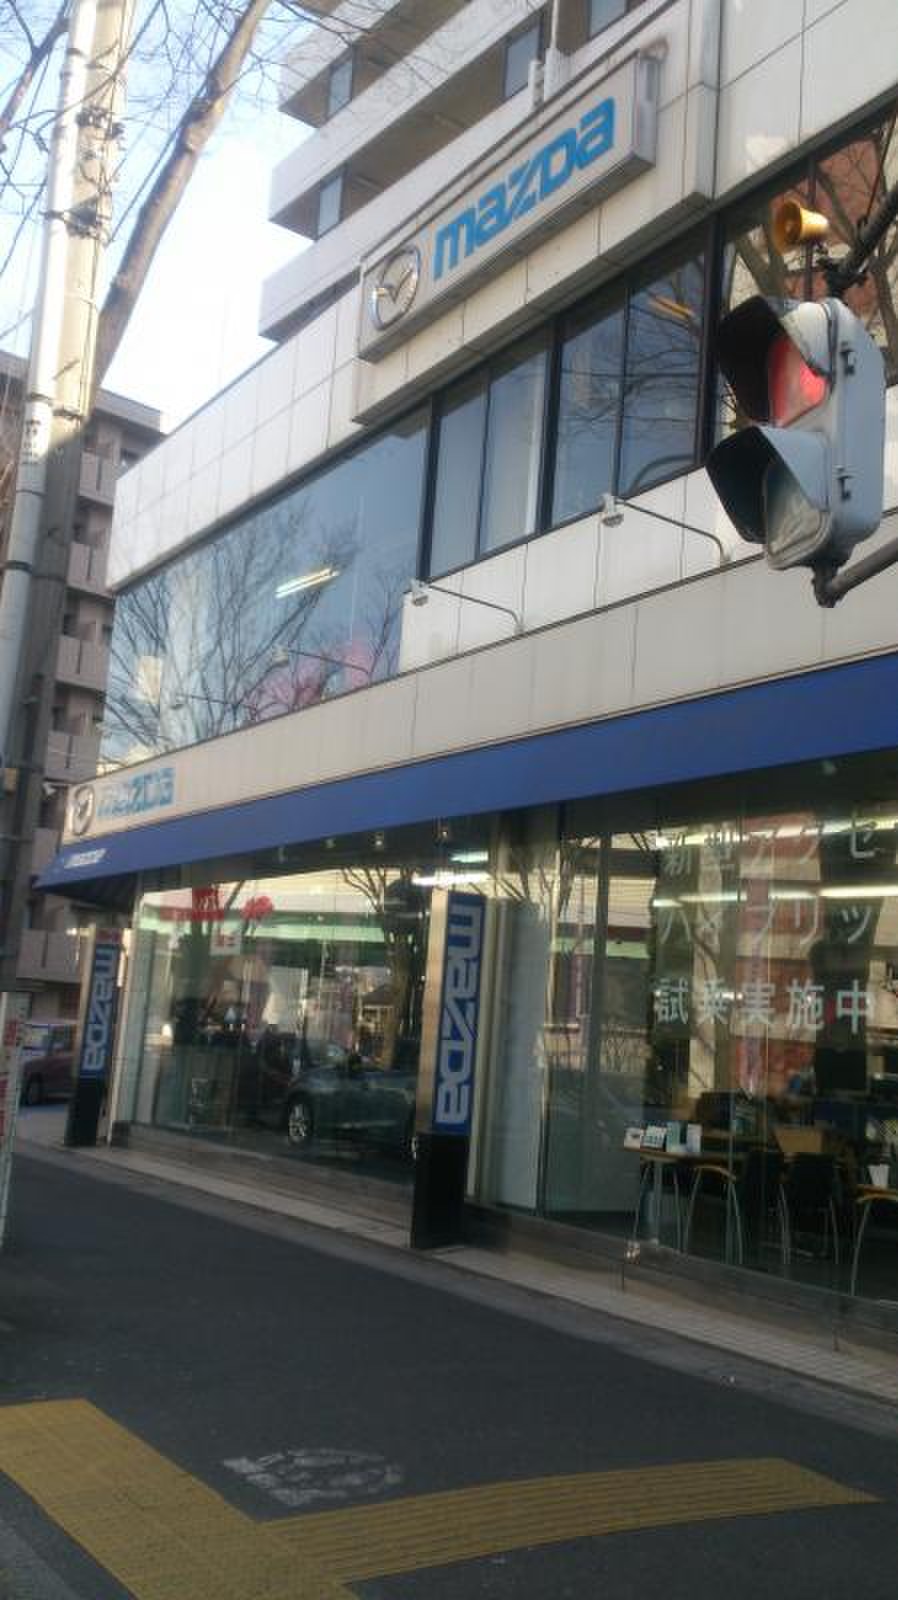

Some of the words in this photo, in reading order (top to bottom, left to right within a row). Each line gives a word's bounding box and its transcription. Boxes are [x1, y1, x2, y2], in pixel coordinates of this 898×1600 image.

[653, 977, 875, 1035] 試乗実施中
